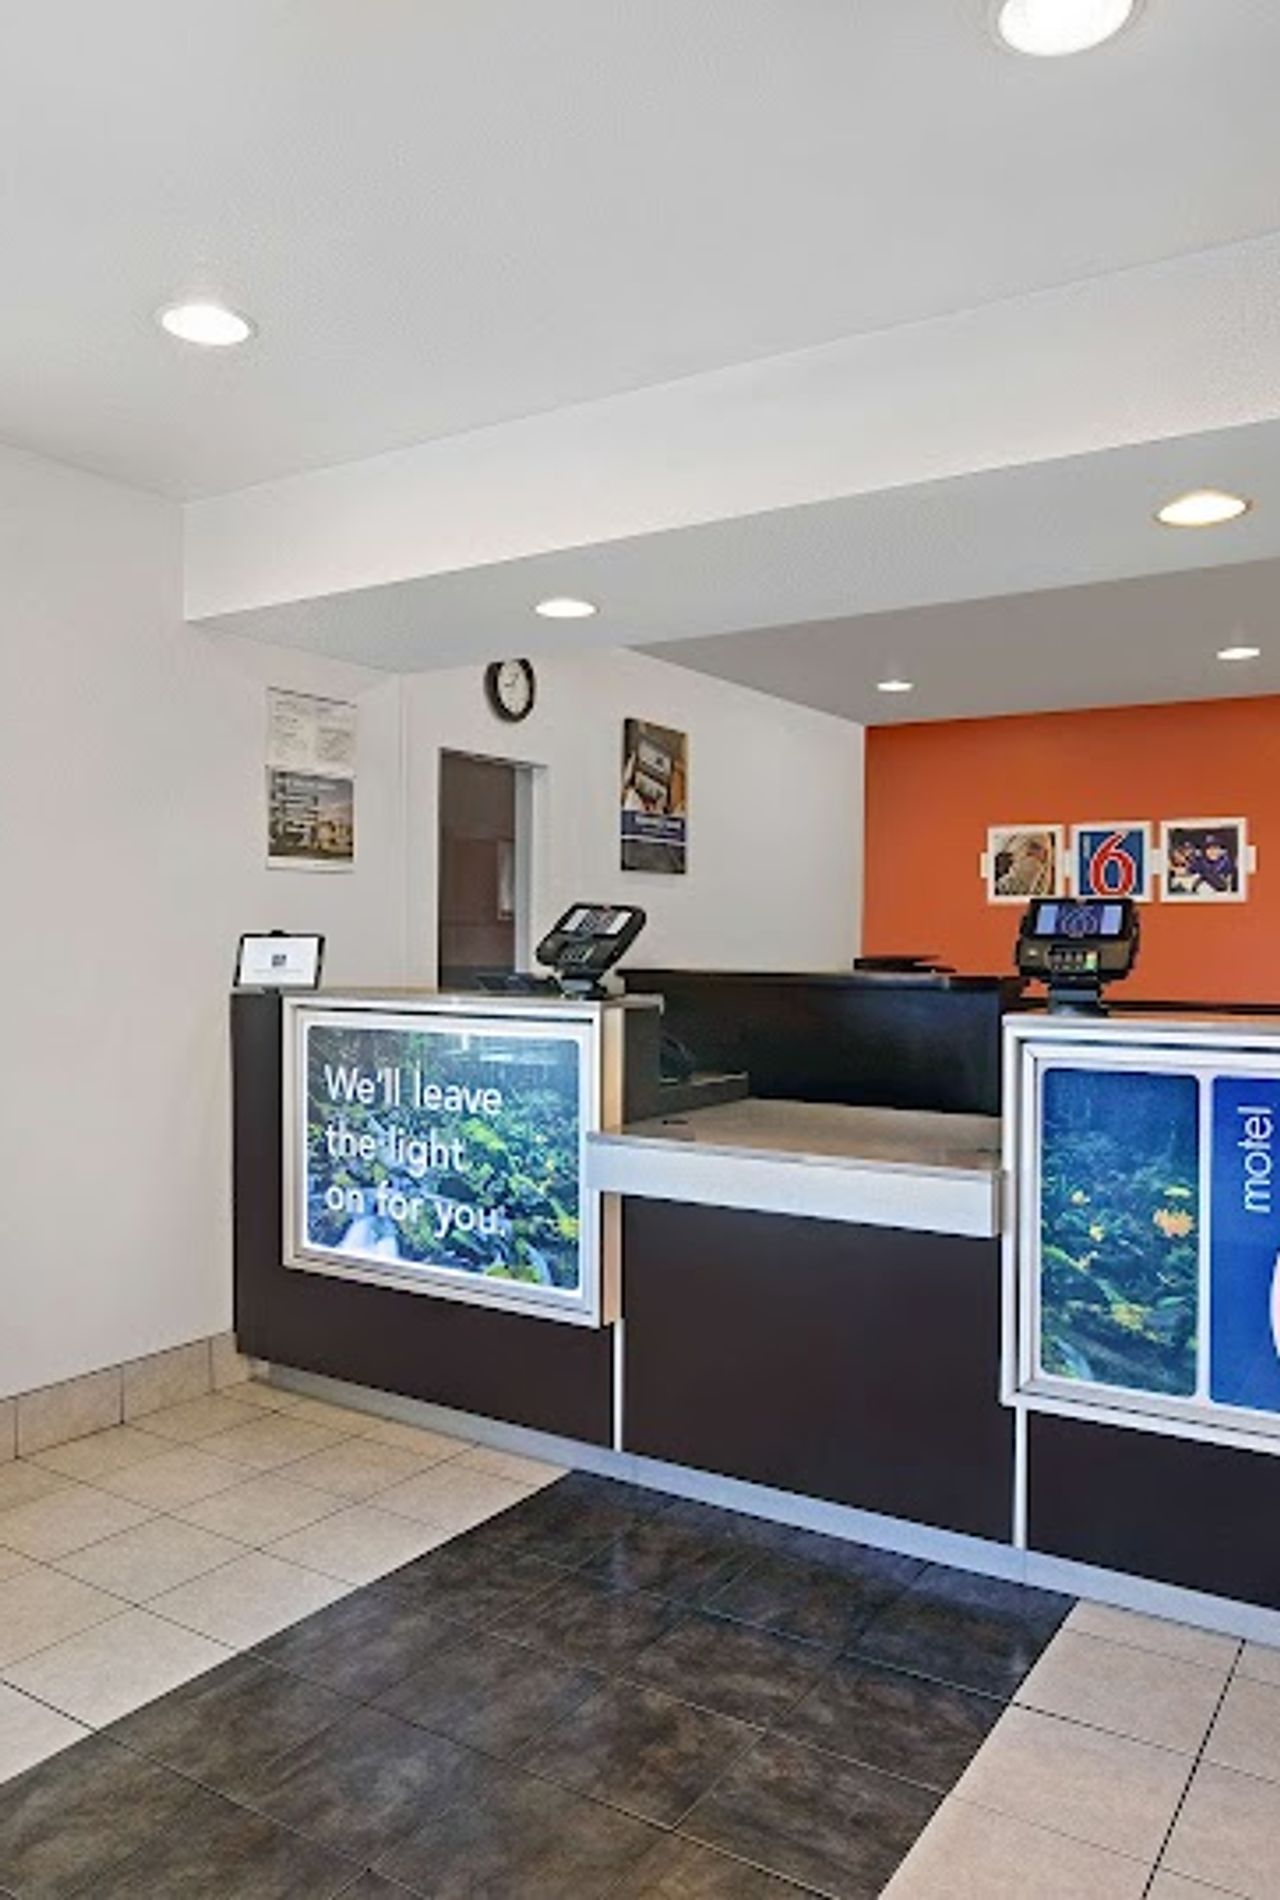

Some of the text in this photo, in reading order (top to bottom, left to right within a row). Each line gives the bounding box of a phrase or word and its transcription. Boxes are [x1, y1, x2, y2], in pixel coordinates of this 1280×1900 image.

[1089, 831, 1136, 896] 6
[324, 1064, 503, 1116] We'll leave
[325, 1120, 465, 1178] the light
[1237, 1105, 1274, 1214] motel
[325, 1186, 364, 1213] on
[376, 1180, 423, 1222] for
